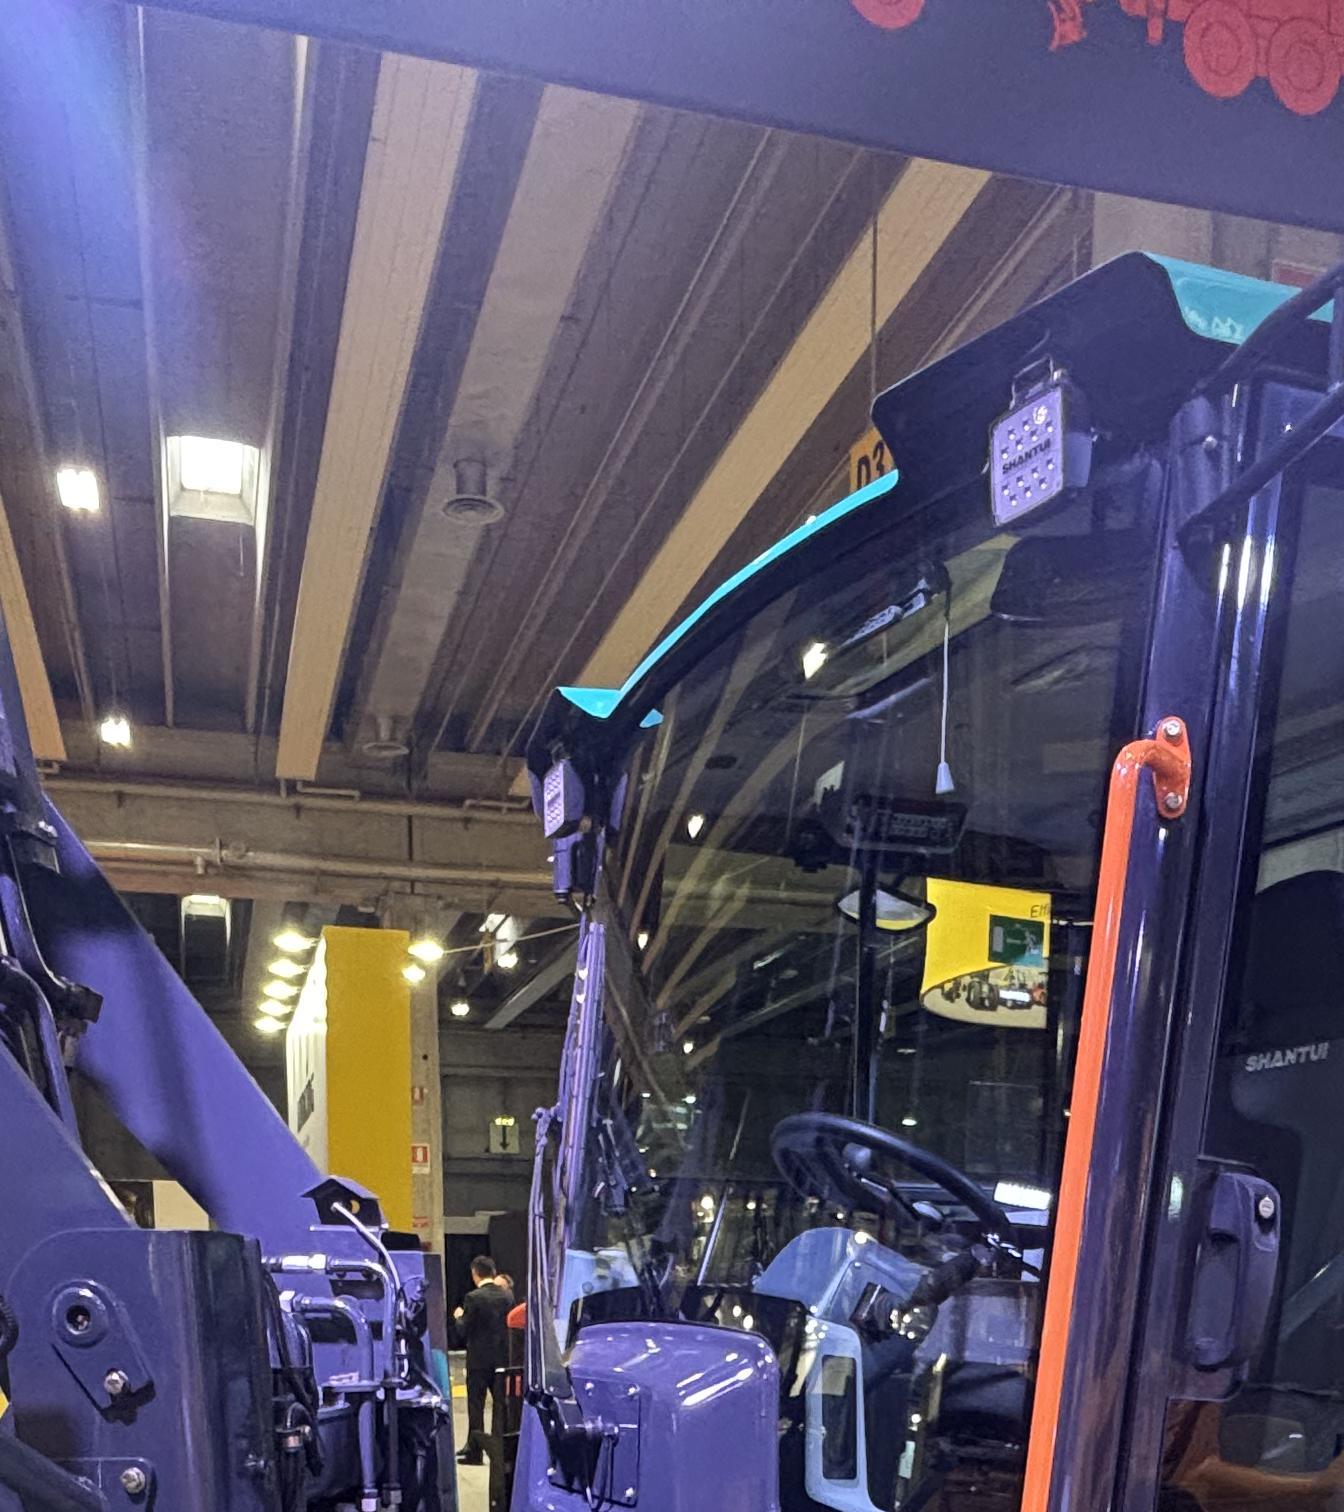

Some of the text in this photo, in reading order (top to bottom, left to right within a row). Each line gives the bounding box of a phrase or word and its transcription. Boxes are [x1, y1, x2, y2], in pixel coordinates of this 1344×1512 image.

[857, 441, 885, 488] D3
[1002, 438, 1051, 475] SHANTUI
[1245, 1042, 1329, 1072] SHANTUI
